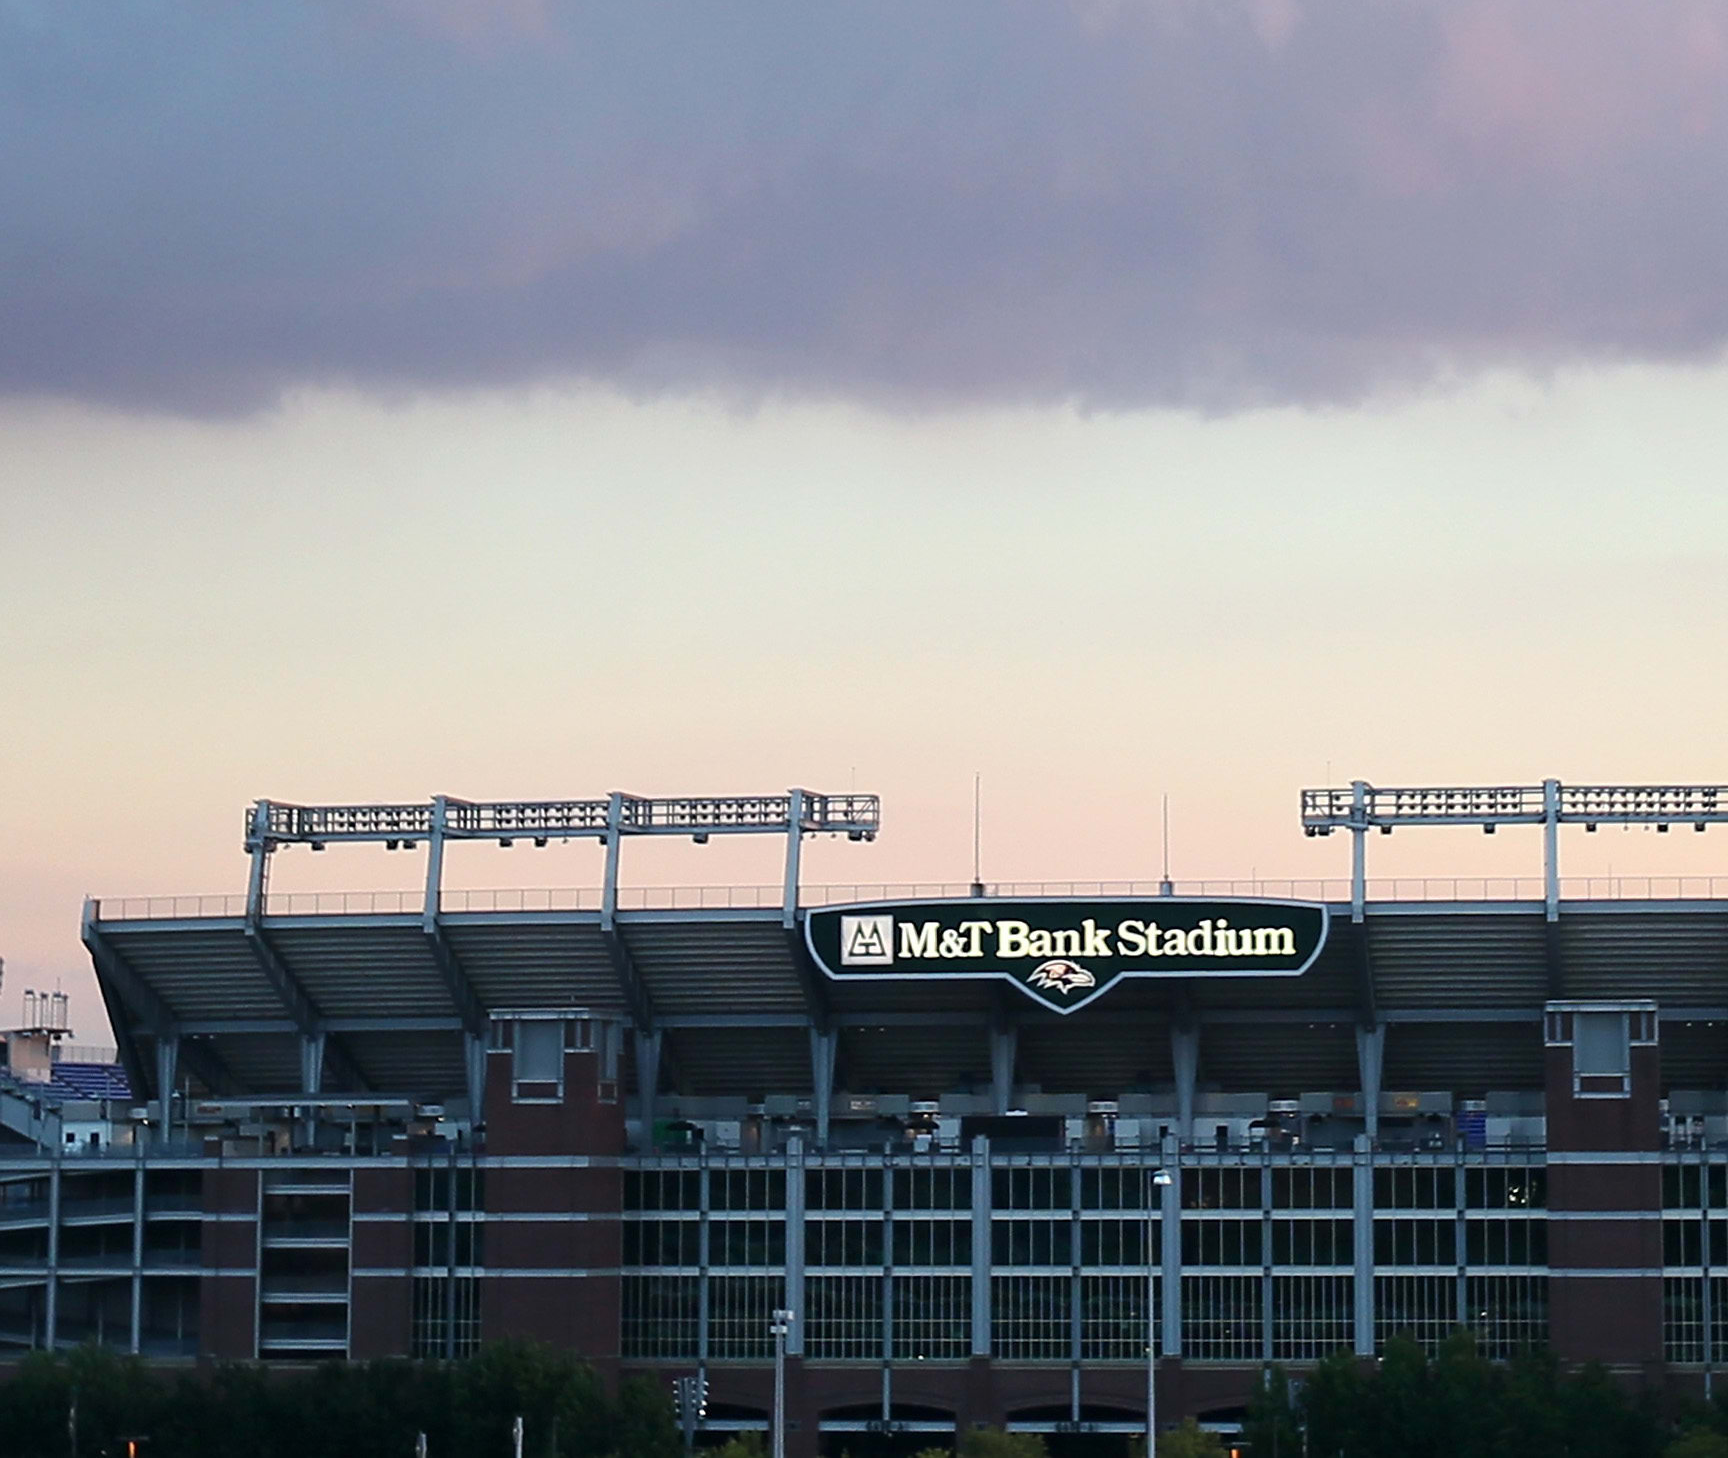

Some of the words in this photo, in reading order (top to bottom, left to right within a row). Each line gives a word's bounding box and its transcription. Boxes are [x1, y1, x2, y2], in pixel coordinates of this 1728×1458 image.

[898, 921, 994, 958] M&T
[996, 919, 1113, 958] Bank
[1117, 918, 1296, 957] Stadium
